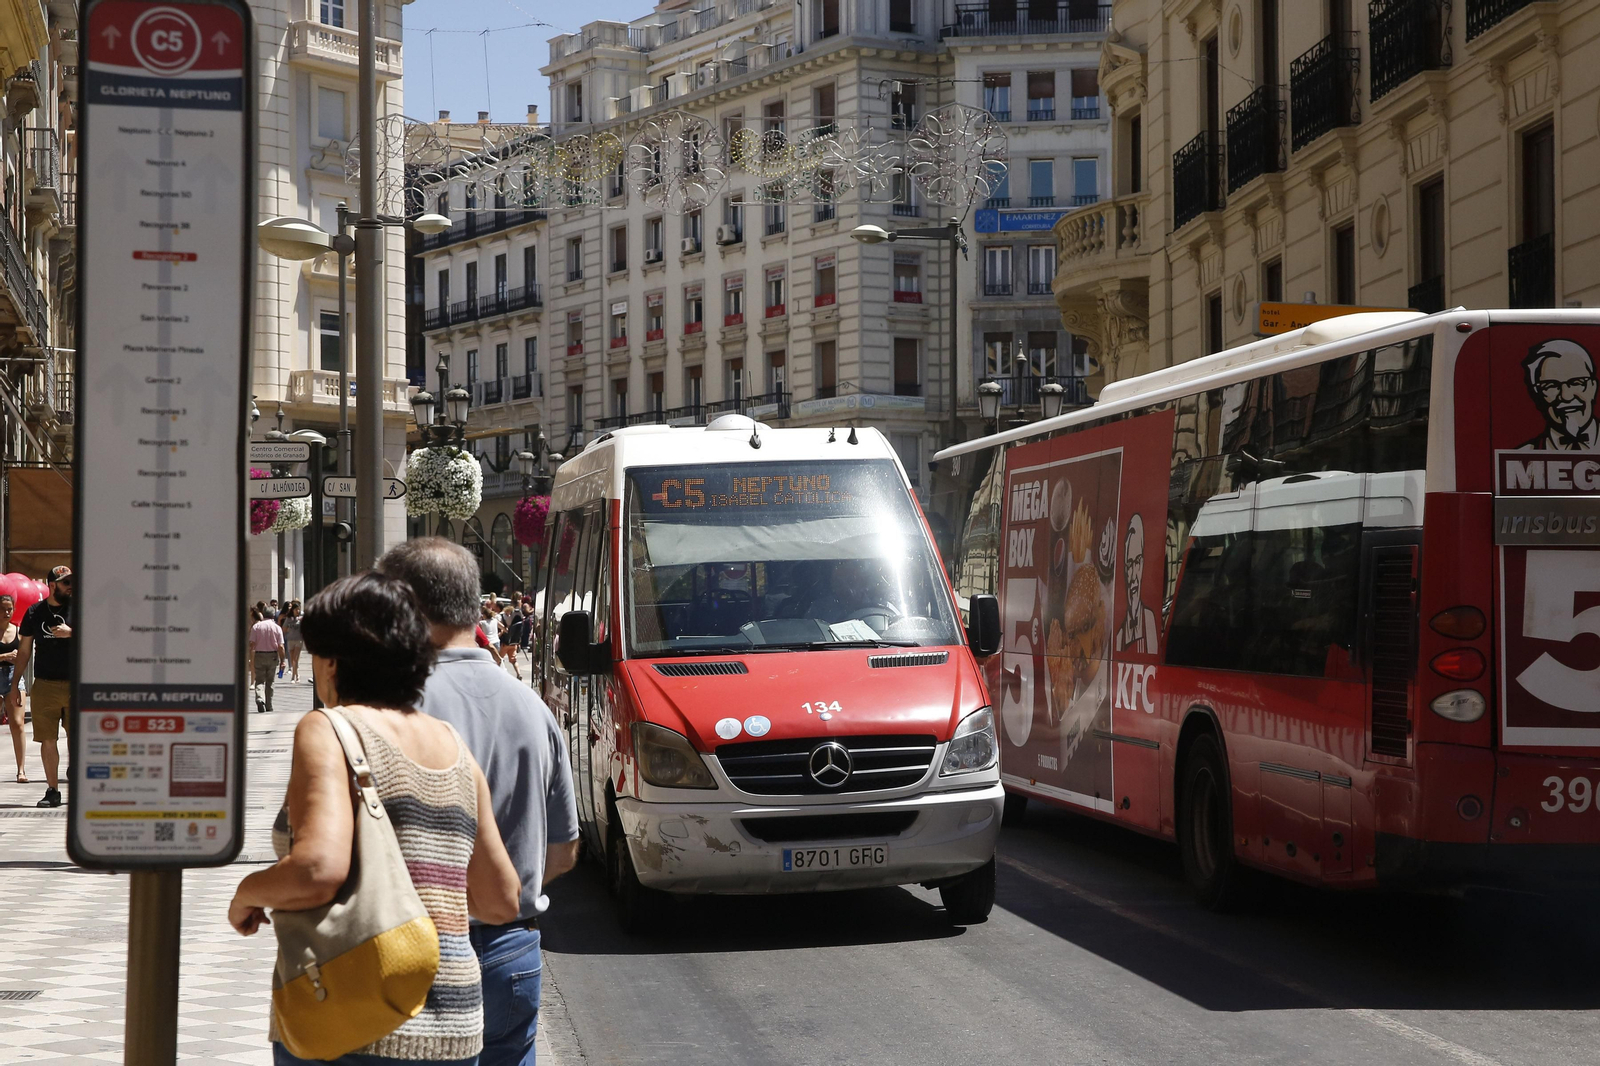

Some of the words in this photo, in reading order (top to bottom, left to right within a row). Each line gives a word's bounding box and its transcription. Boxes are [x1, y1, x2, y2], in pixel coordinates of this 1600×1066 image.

[151, 30, 183, 52] C5
[100, 85, 165, 98] GLORIETA
[170, 89, 231, 101] NEPTUNO
[141, 190, 179, 198] Recogidas
[140, 221, 178, 229] Recogidas
[141, 407, 179, 416] Recogidas
[138, 438, 177, 447] Recogidas
[138, 470, 176, 478] Recogidas
[260, 484, 268, 492] C/
[272, 481, 306, 492] ALHÓNDIGA
[328, 482, 335, 492] C/
[340, 483, 350, 492] SAN
[661, 478, 705, 508] C5
[732, 475, 830, 493] NEPTUNO
[711, 494, 768, 507] ISABEL
[773, 491, 853, 505] CATOLICA
[1011, 479, 1048, 522] MEGA
[1501, 512, 1597, 534] irisbus
[1008, 528, 1035, 568] BOX
[1515, 549, 1600, 713] 5
[1114, 663, 1157, 714] KFC
[93, 692, 158, 702] GLORIETA
[162, 692, 223, 702] NEPTUNO
[801, 700, 842, 714] 134
[147, 719, 176, 731] 523
[1540, 776, 1600, 813] 39
[794, 850, 839, 868] 8701
[850, 848, 884, 865] GFG
